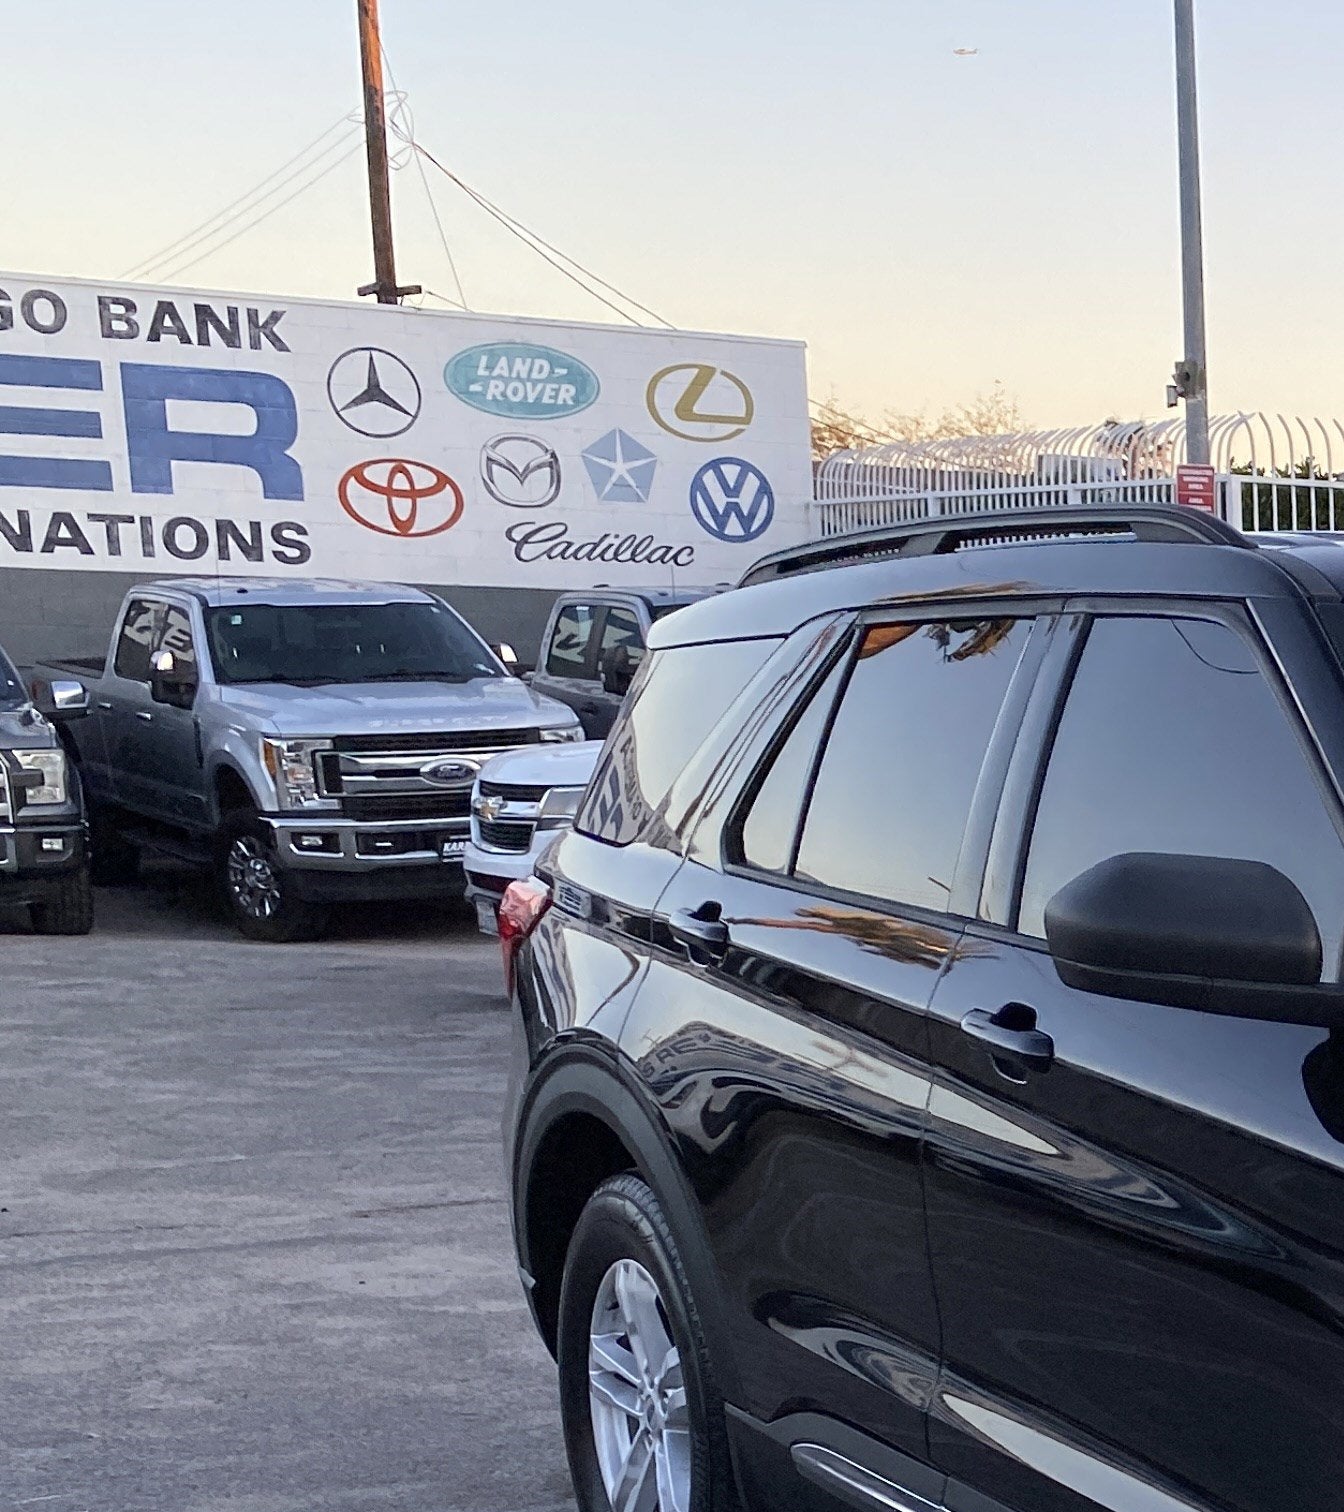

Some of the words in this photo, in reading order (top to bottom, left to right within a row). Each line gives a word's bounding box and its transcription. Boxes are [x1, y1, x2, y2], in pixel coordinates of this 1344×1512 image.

[0, 287, 68, 335] O
[97, 294, 292, 353] BANK
[0, 508, 312, 565] NATIONS
[504, 521, 695, 567] Cadillac
